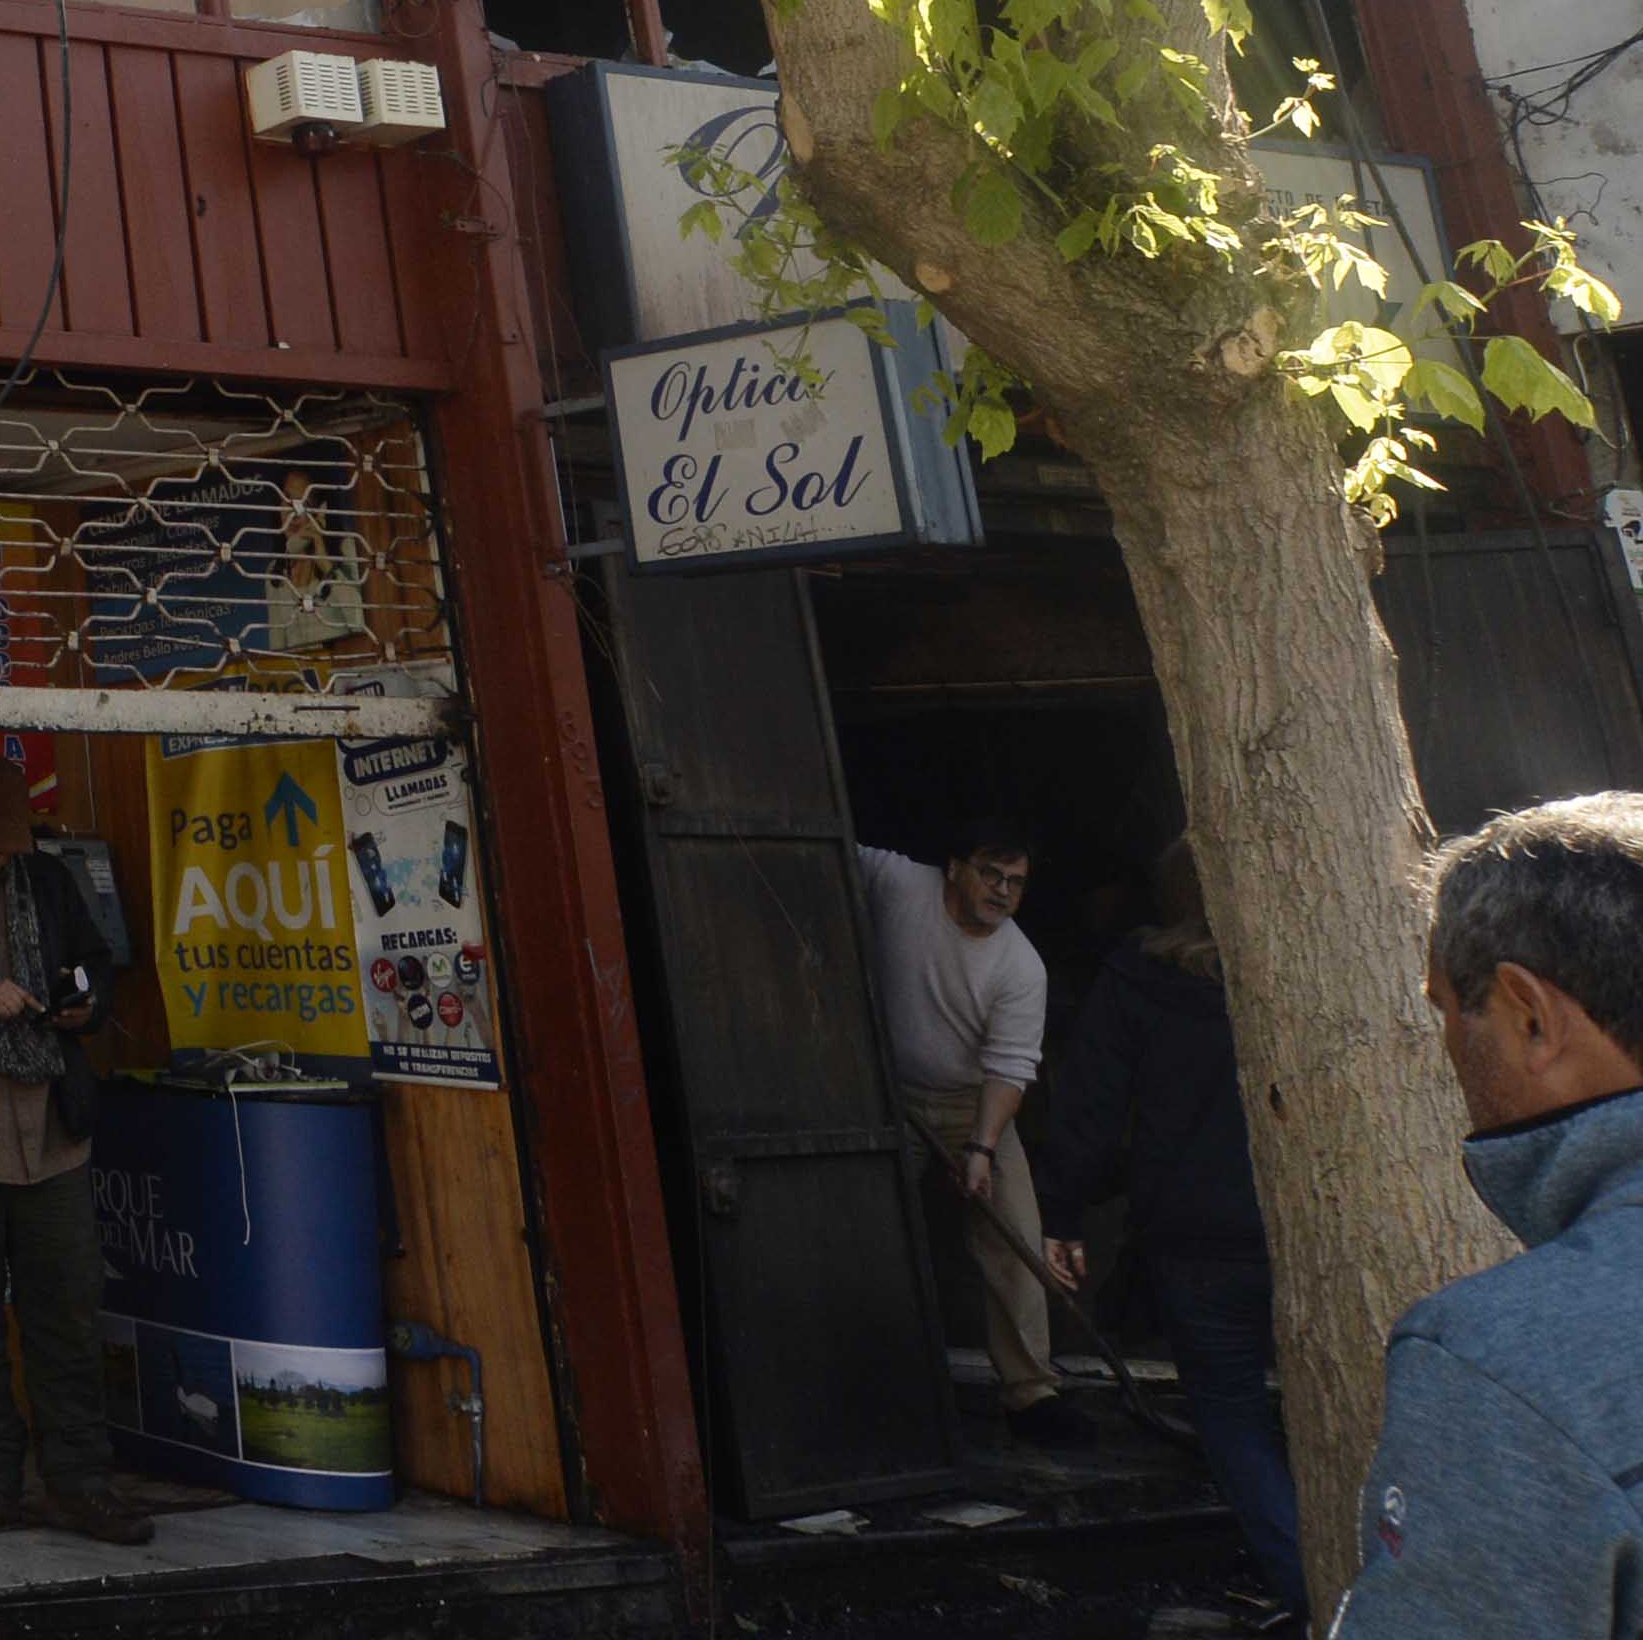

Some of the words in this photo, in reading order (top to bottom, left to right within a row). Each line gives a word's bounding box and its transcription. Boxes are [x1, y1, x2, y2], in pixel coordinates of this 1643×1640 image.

[647, 453, 731, 525] El
[744, 435, 872, 517] Sol
[353, 740, 437, 778] INTERNET
[385, 774, 447, 802] LLAMADAS
[170, 808, 253, 851] Paga
[172, 844, 338, 941] AQUÍ
[174, 940, 230, 973] tus
[237, 937, 353, 972] cuentas
[381, 927, 458, 951] RECARGAS:
[218, 981, 356, 1022] recargas
[130, 1216, 199, 1279] MAR
